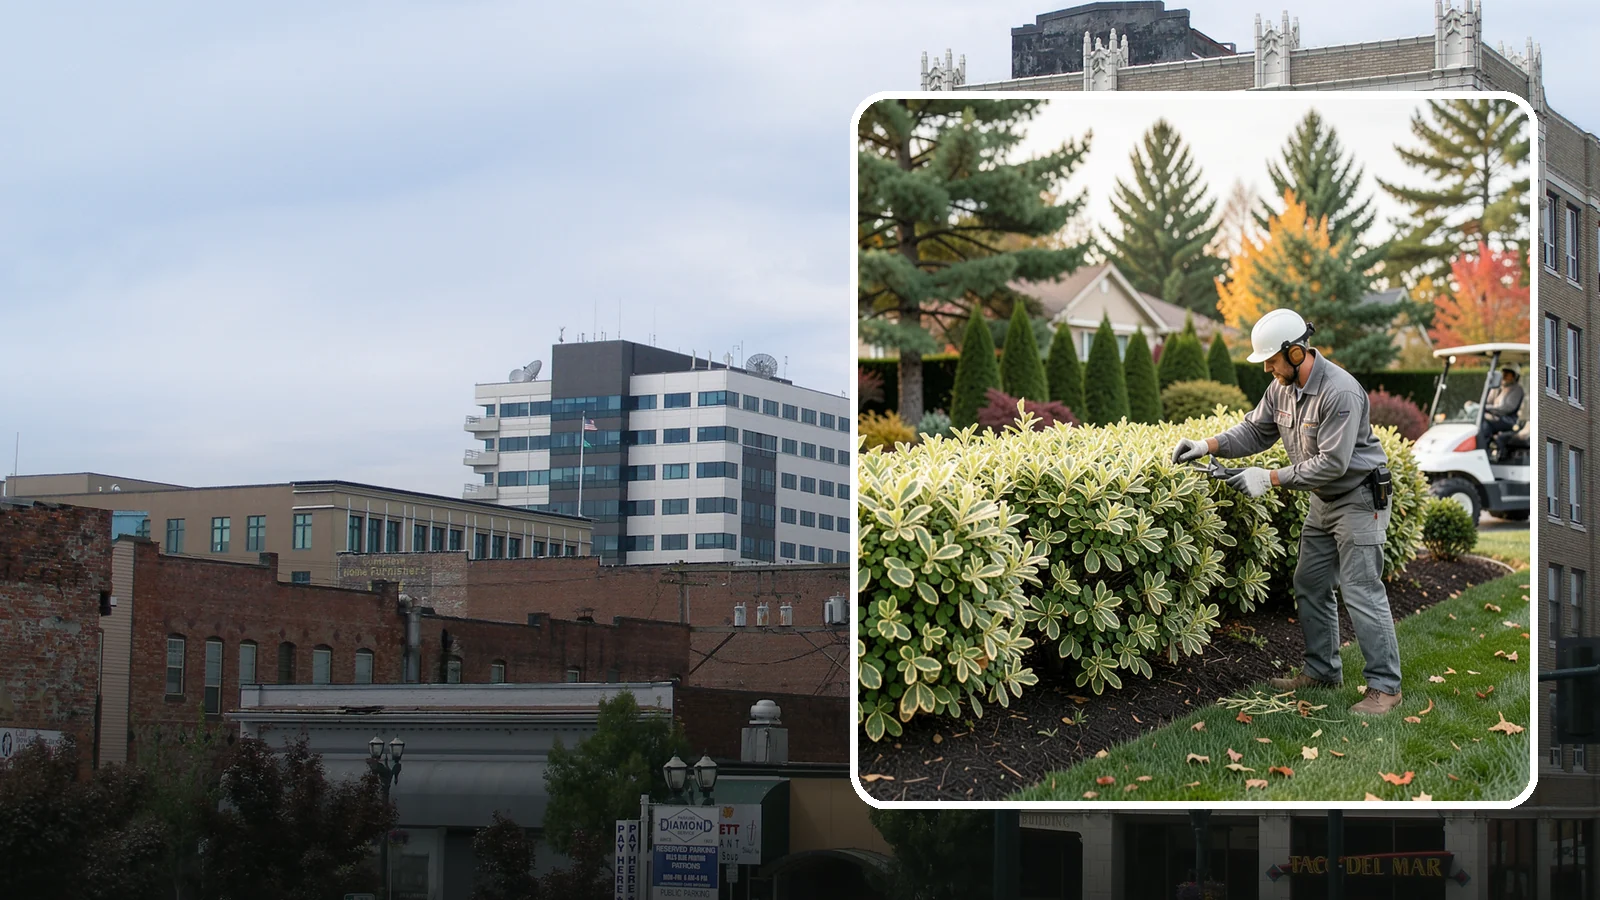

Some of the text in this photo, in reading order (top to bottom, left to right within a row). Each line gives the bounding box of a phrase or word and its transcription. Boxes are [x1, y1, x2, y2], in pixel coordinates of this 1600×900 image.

[343, 566, 427, 577] Home Furnishers
[660, 818, 713, 832] DIAMOND
[1021, 815, 1070, 828] BUILDING
[617, 825, 625, 852] PAY
[628, 824, 636, 852] PAY
[656, 845, 716, 854] RESERVED PARKING
[721, 851, 739, 862] Soup
[671, 862, 701, 870] PATRONS
[1346, 856, 1384, 876] DEL
[1392, 857, 1442, 877] MAR
[616, 856, 625, 893] HERE
[628, 856, 636, 893] HERE
[660, 889, 710, 898] PUBLIC PARKING
